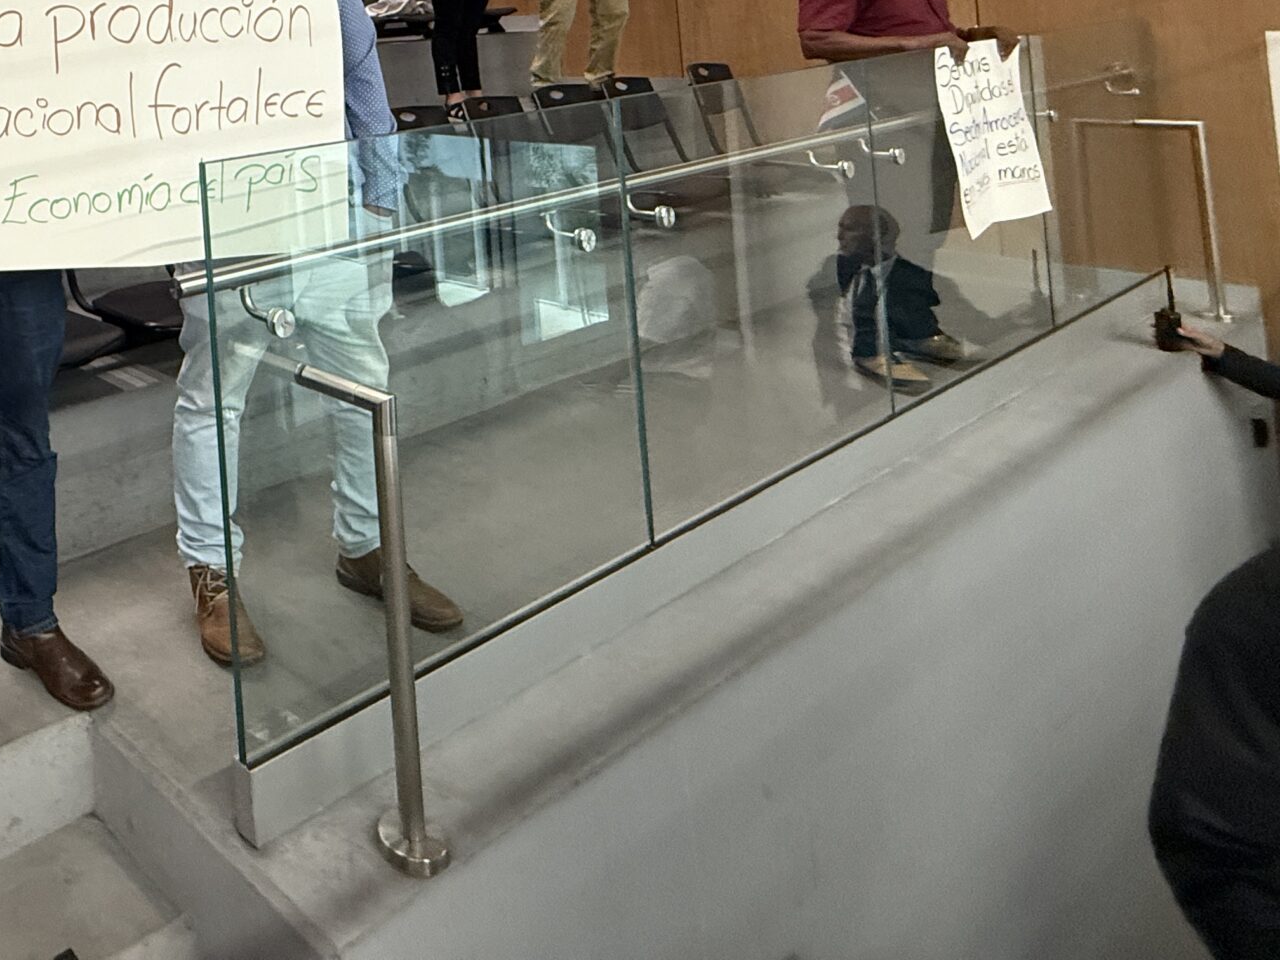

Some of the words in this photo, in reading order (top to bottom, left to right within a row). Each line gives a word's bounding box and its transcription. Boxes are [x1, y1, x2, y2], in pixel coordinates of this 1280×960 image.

[148, 63, 326, 140] fortalece
[1, 173, 172, 224] Economía
[234, 151, 322, 213] país
